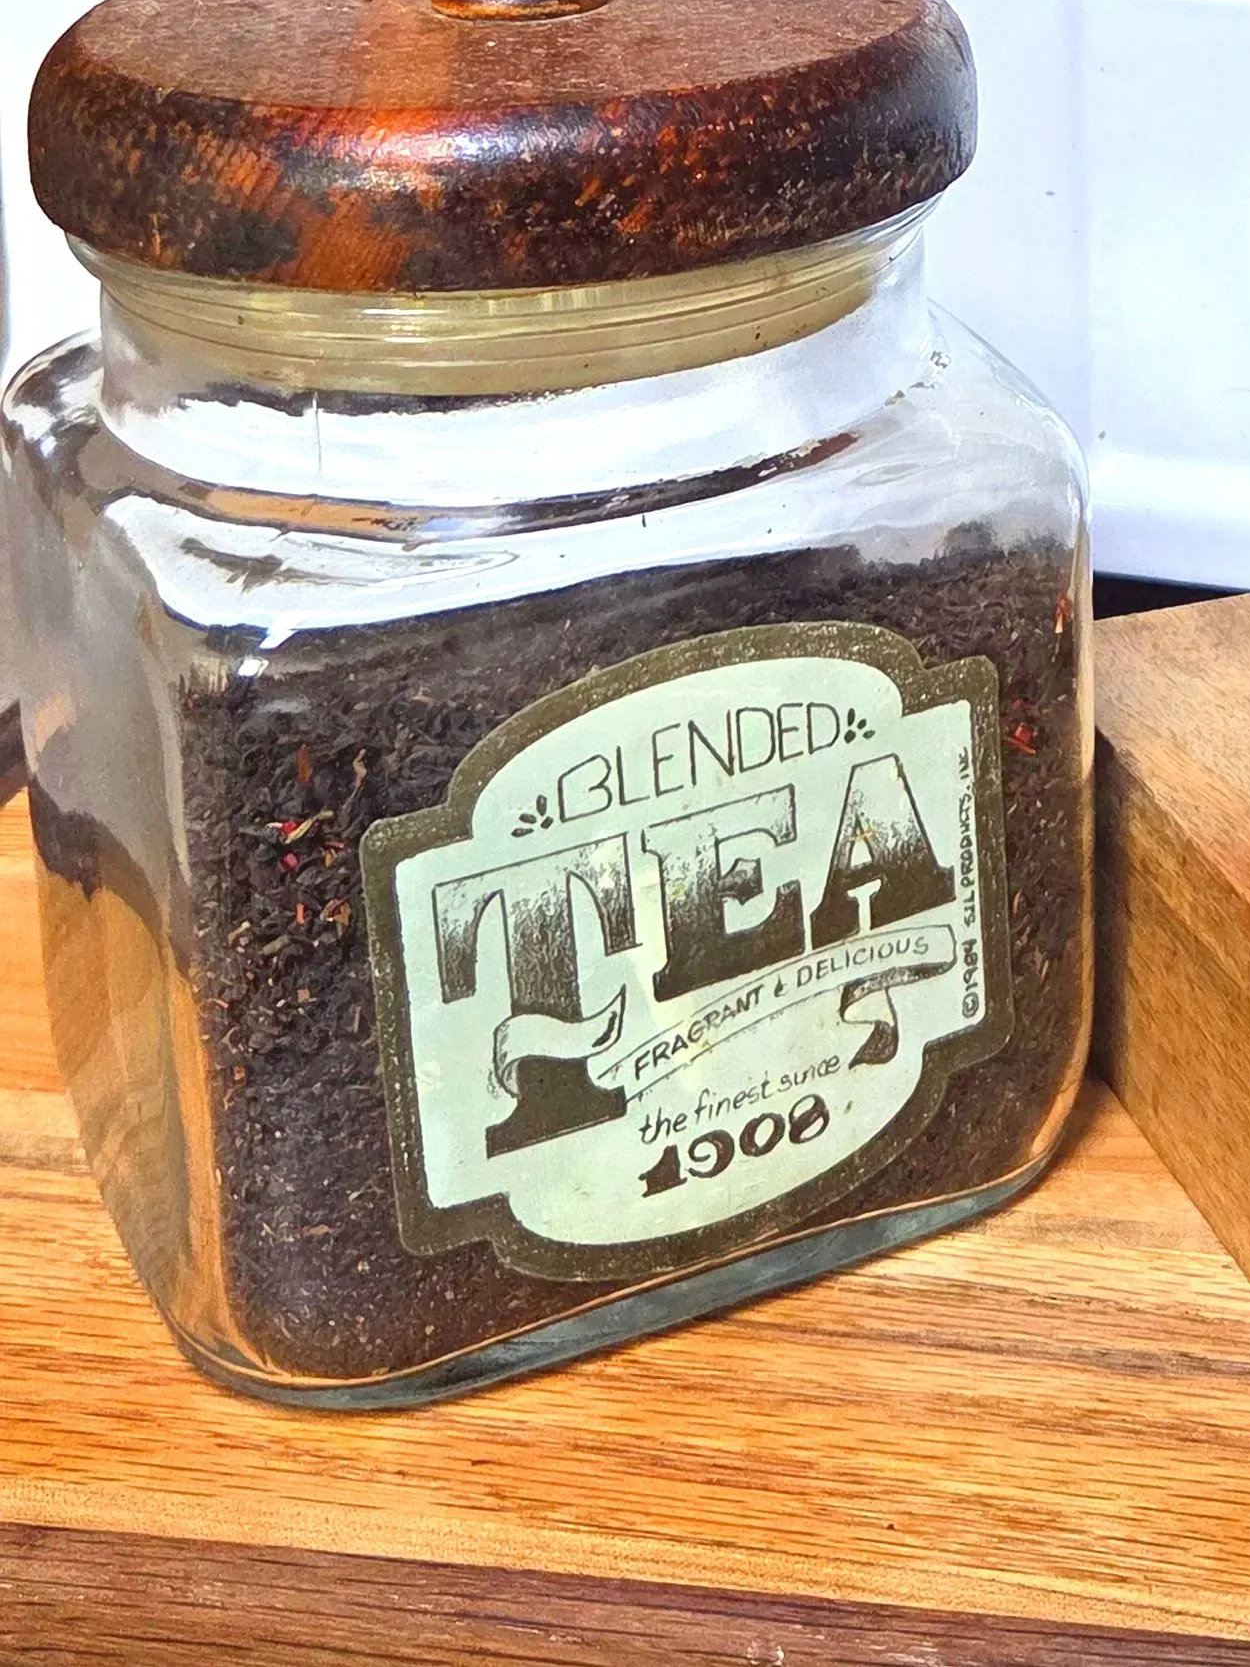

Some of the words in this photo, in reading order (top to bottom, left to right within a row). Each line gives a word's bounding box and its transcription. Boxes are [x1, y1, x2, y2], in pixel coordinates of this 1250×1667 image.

[557, 701, 841, 824] BLENDED
[432, 752, 956, 1159] TEA
[634, 984, 765, 1080] FRAGRANT
[796, 936, 930, 988] DELICIOUS
[638, 1107, 689, 1144] the
[694, 1071, 771, 1125] finest
[776, 1054, 841, 1093] since
[638, 1094, 831, 1198] 1908
